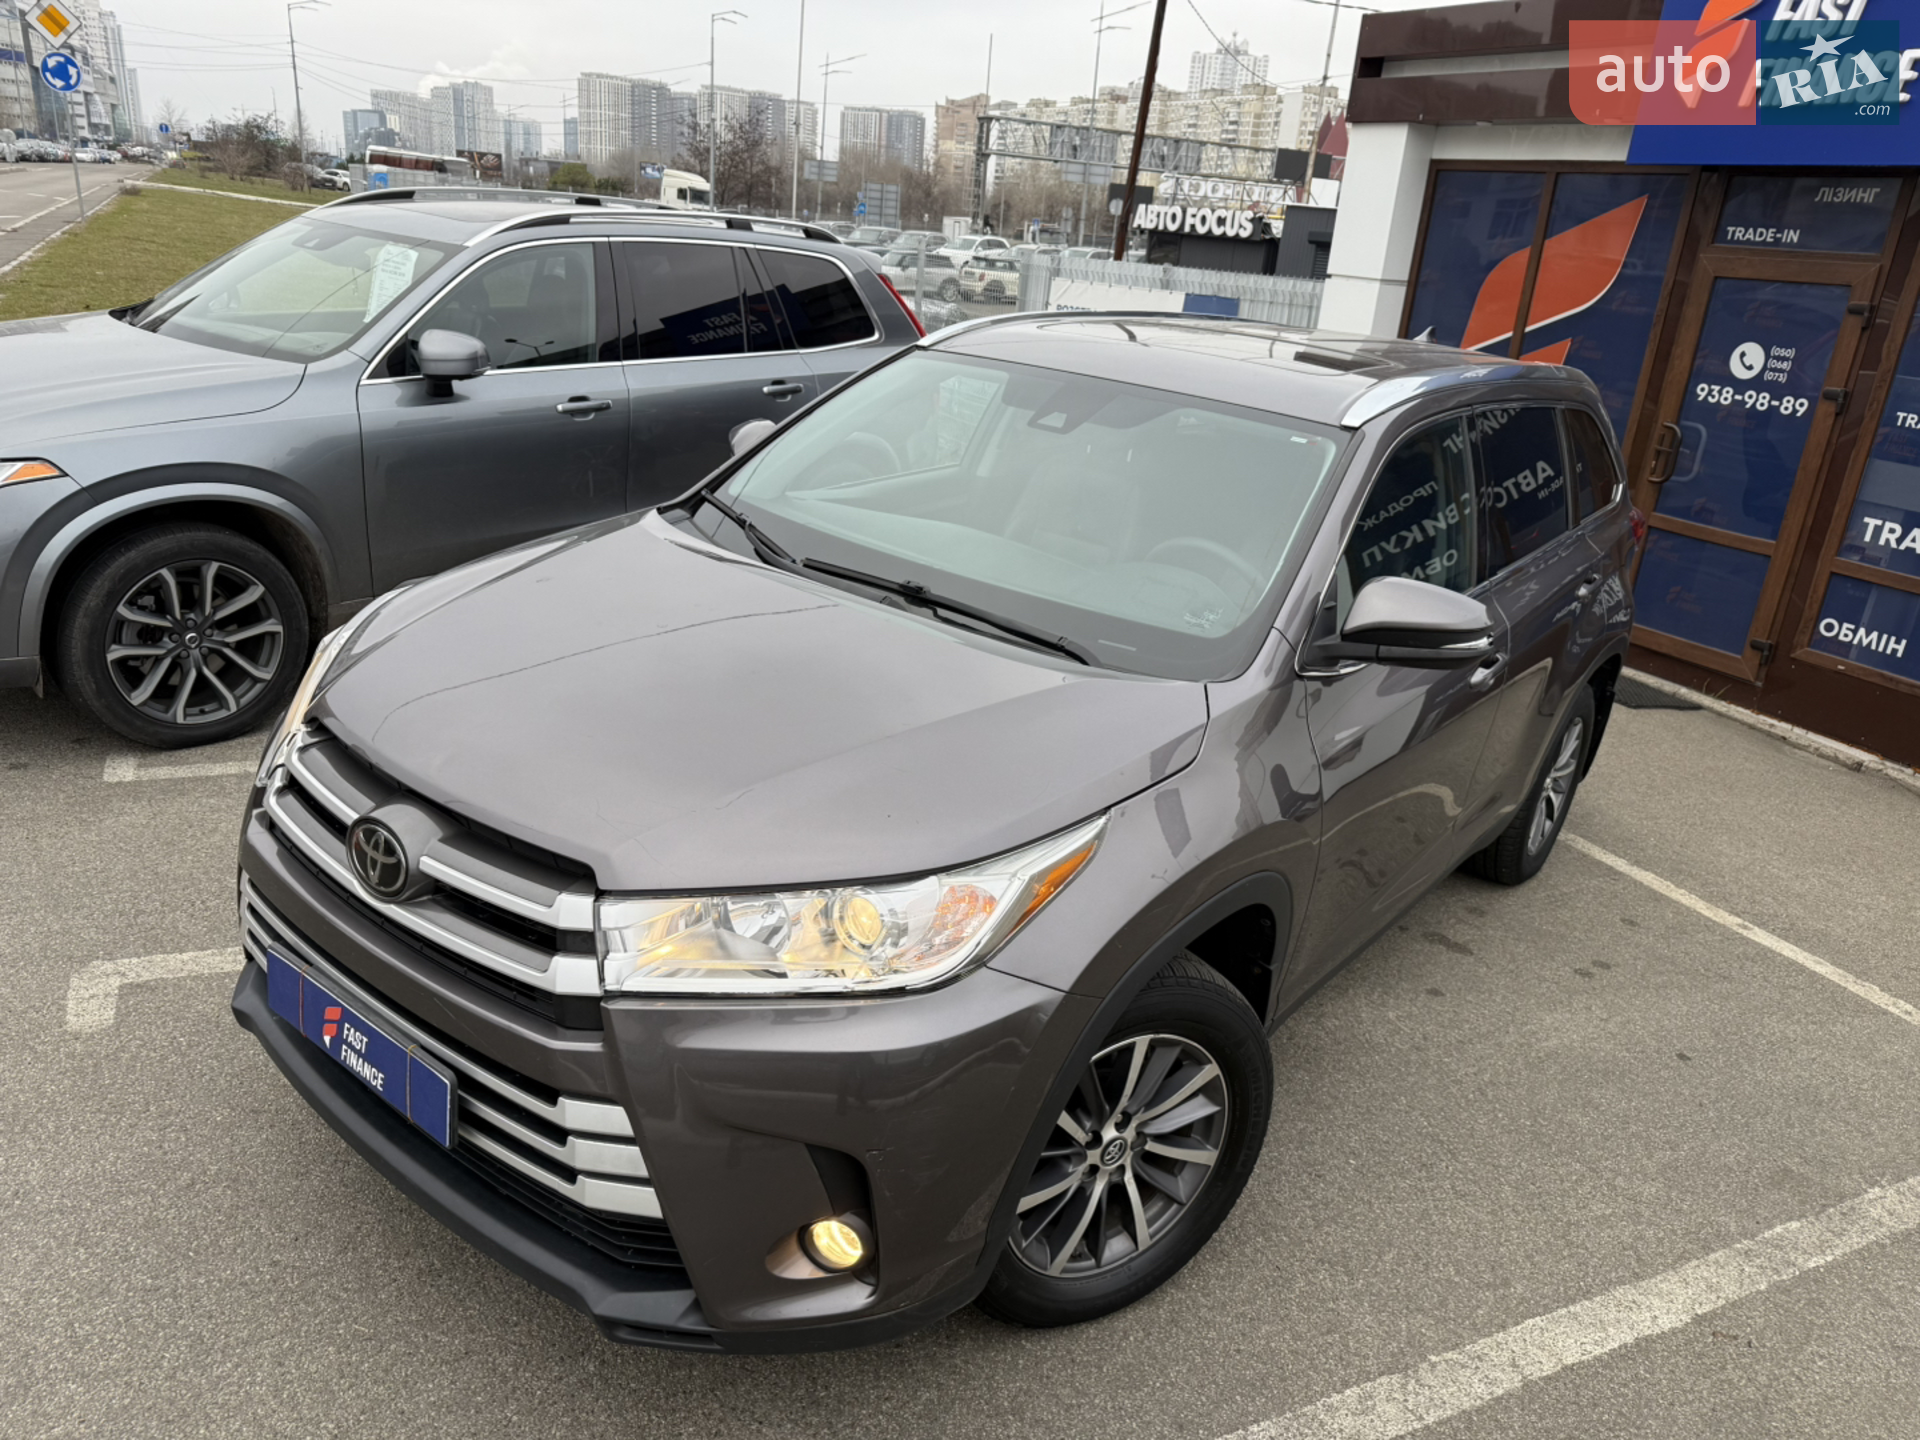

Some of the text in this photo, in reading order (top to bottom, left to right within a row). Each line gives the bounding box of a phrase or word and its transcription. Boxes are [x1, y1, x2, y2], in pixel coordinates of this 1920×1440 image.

[1737, 48, 1920, 107] FINANCE
[1814, 187, 1880, 203] ЛІЗИНГ
[1133, 203, 1254, 238] АВТО FOCUS
[1726, 226, 1800, 243] TRADE-IN
[1767, 358, 1792, 371] (068)
[1770, 345, 1795, 359] (050)
[1763, 370, 1787, 383] (073)
[1696, 383, 1809, 417] 938-98-89
[1863, 516, 1920, 555] TRA
[1819, 617, 1907, 658] ОБМІН
[343, 1022, 368, 1054] FAST
[341, 1043, 385, 1092] FINANCE
